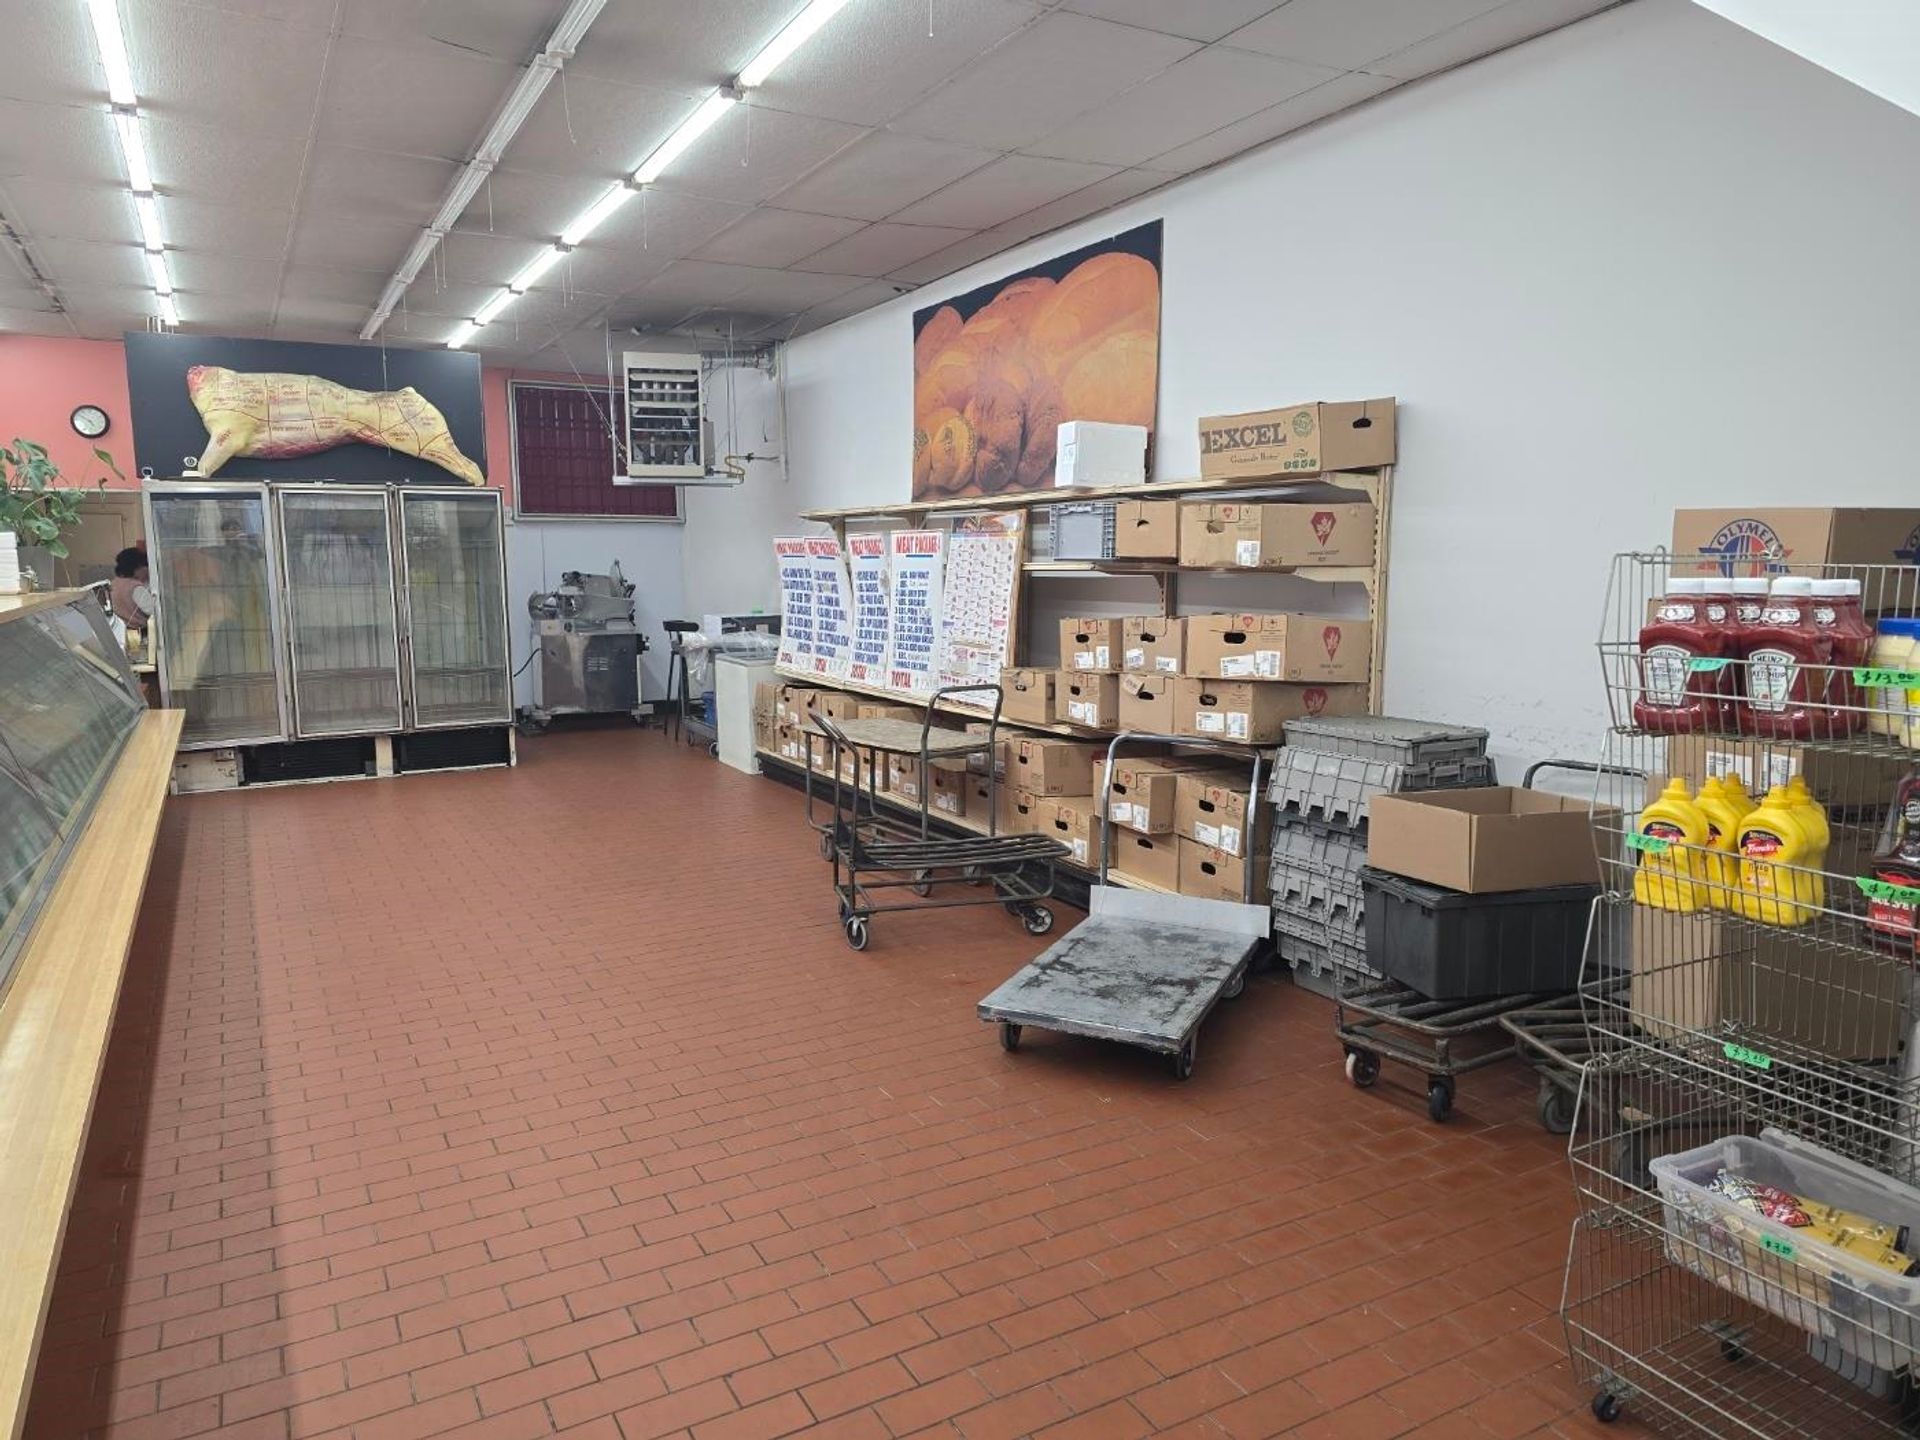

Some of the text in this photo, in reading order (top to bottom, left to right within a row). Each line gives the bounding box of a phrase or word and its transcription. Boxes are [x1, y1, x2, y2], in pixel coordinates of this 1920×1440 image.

[1201, 422, 1287, 454] EXCEL
[896, 535, 914, 554] MEAT
[1717, 522, 1775, 548] OLYMEL
[1757, 655, 1783, 664] HEINZ
[891, 671, 911, 688] TOTAL
